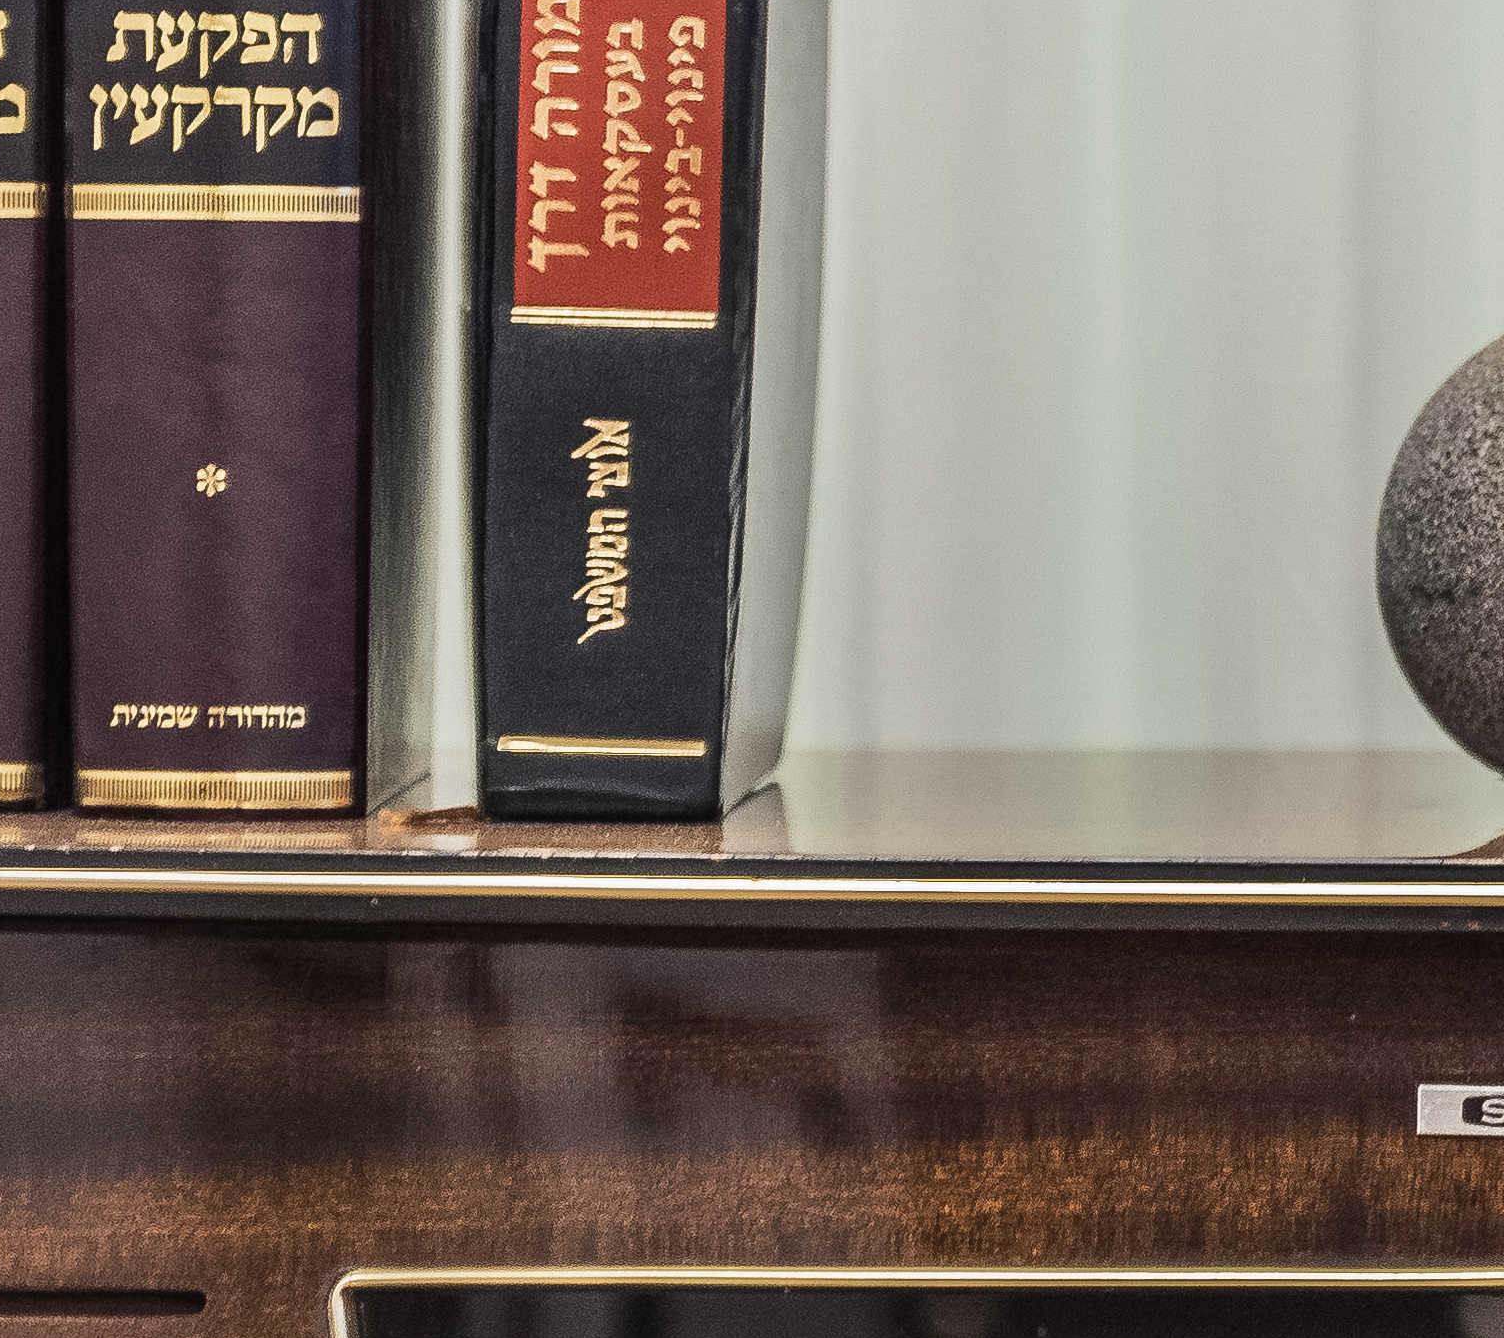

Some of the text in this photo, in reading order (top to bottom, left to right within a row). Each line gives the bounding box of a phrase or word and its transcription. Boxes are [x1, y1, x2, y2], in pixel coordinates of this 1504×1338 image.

[106, 9, 324, 76] הפקעת
[89, 82, 340, 153] מקרקעין
[600, 17, 653, 250] בעסקאות
[527, 160, 590, 273] דרך
[570, 418, 631, 645] אוצר המשפט
[109, 704, 306, 729] מהדורה שמינית
